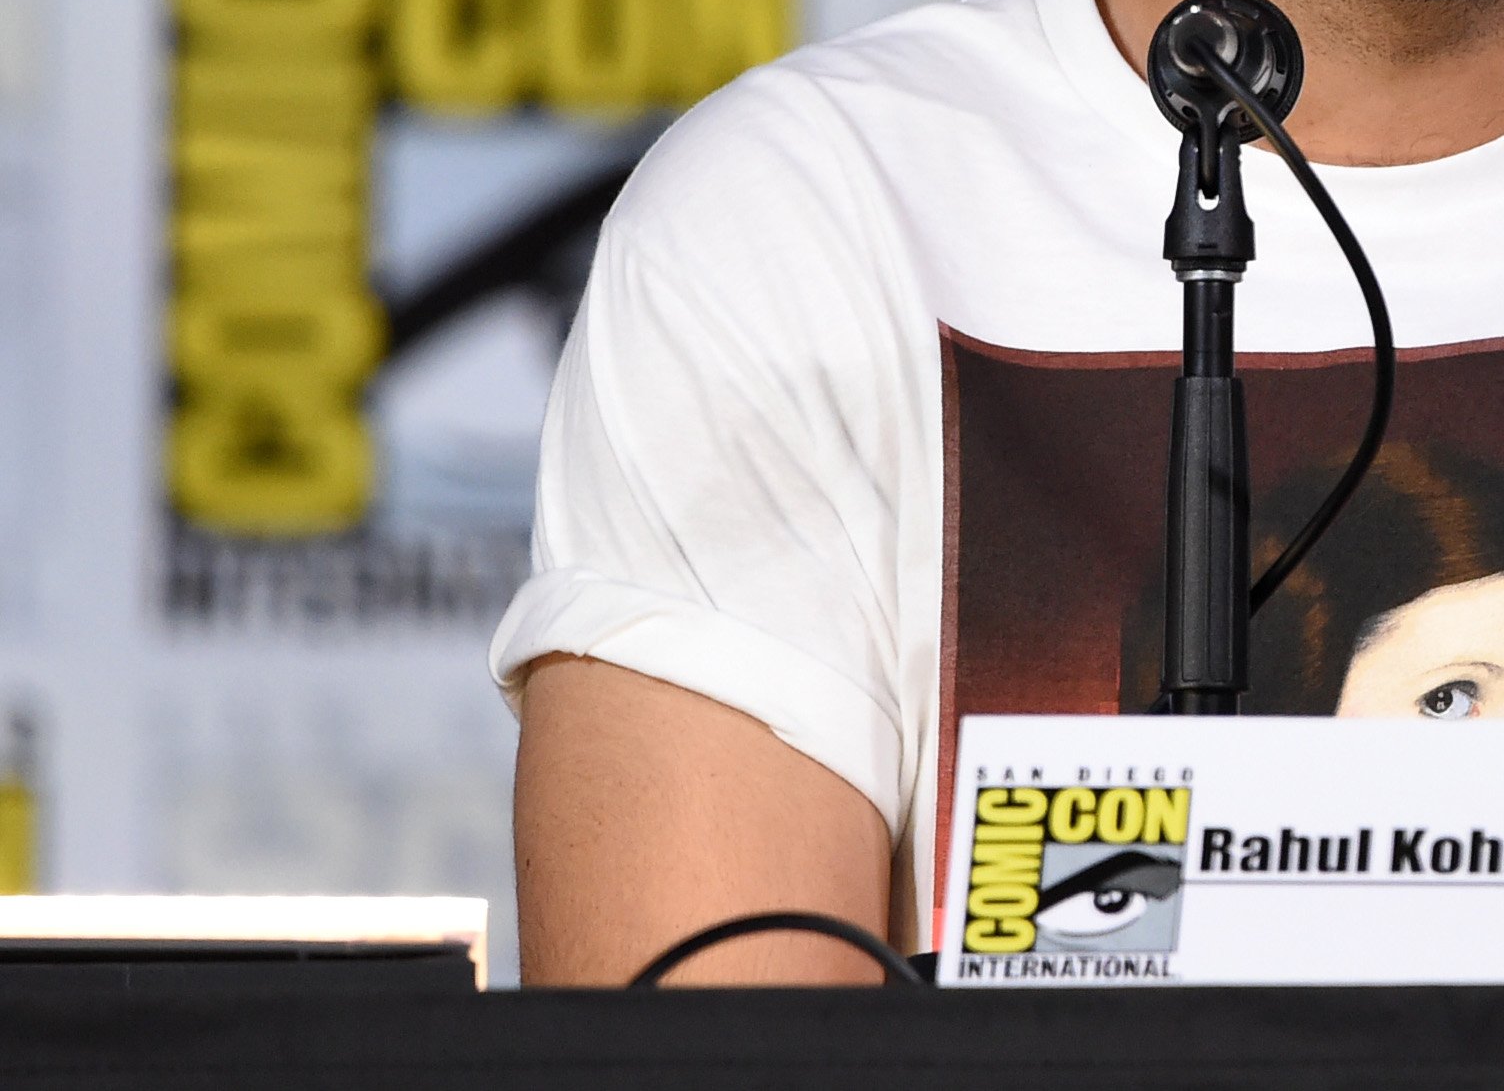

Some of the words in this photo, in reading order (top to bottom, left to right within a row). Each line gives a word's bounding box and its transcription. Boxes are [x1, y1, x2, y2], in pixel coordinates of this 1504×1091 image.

[976, 766, 1044, 783] SAN
[1078, 766, 1195, 783] DIEGO
[1050, 786, 1191, 846] CON
[963, 786, 1049, 955] COMIC
[1199, 826, 1373, 873] Rahul
[957, 954, 1172, 979] INTERNATIONAL
